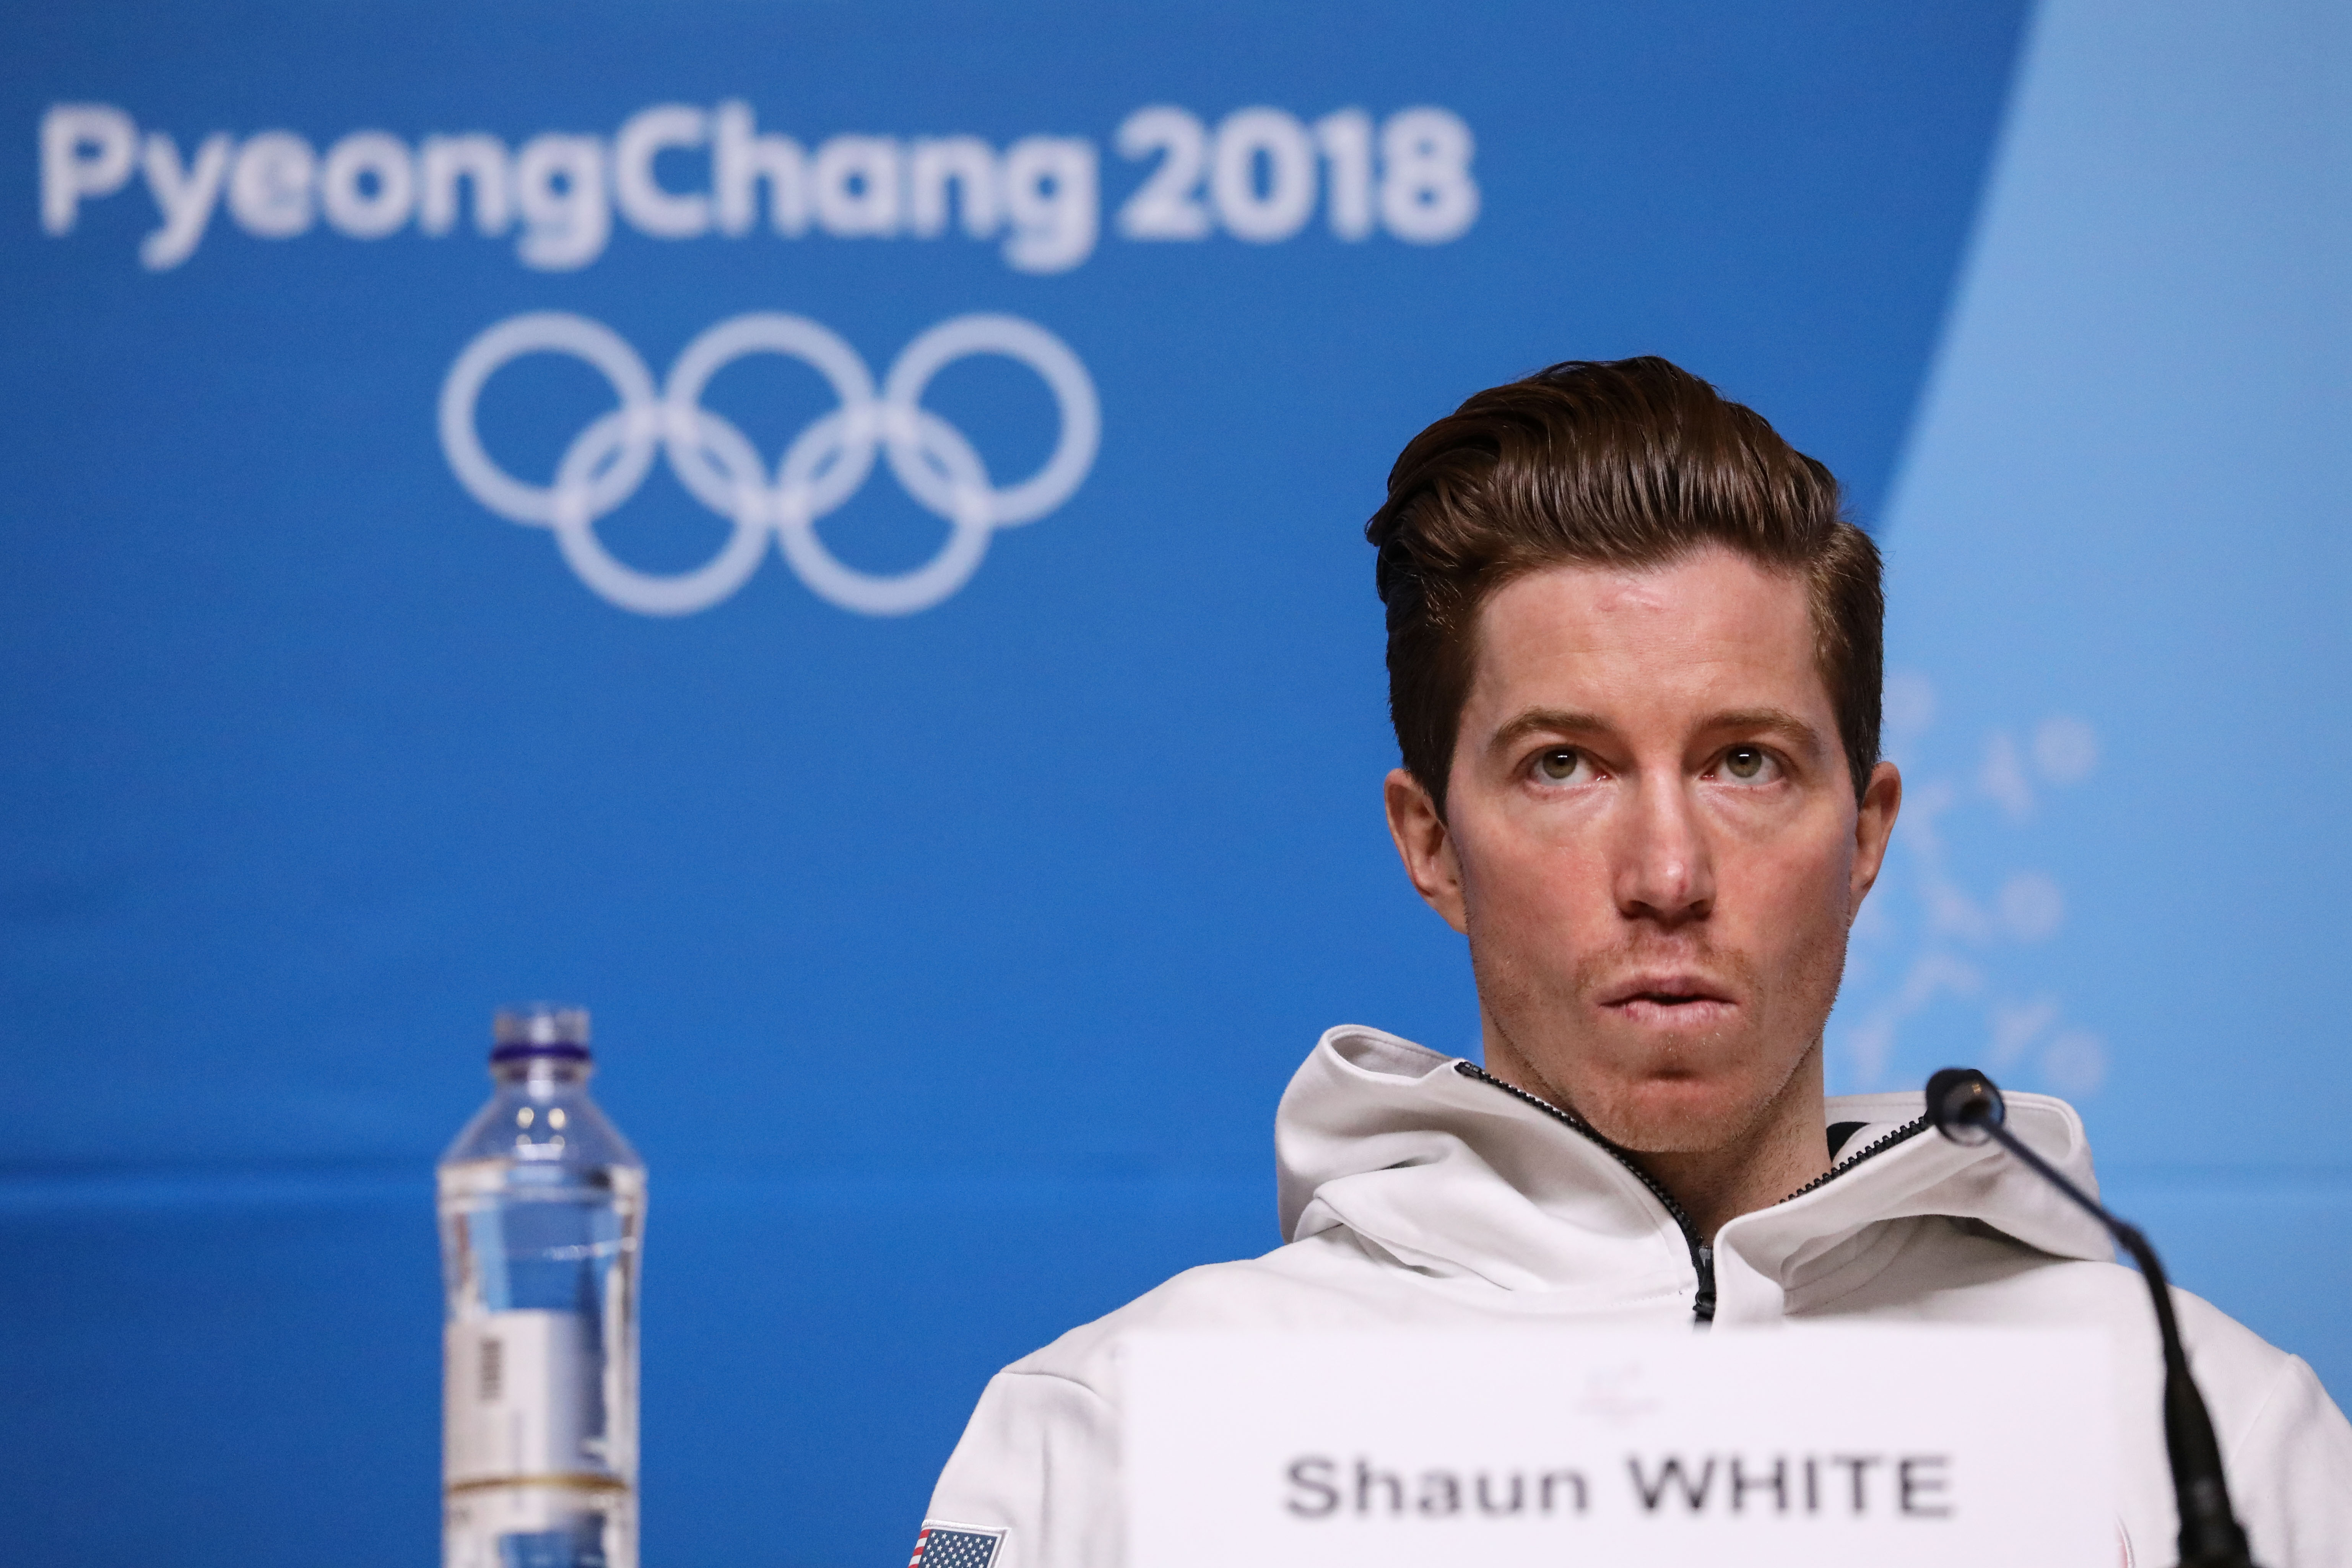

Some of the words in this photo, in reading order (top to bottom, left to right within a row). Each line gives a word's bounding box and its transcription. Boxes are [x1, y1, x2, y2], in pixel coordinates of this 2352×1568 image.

[41, 102, 1099, 270] PyeongChang
[1118, 106, 1479, 242] 2018
[1285, 1454, 1588, 1519] Shaun
[1627, 1454, 1956, 1516] WHITE
